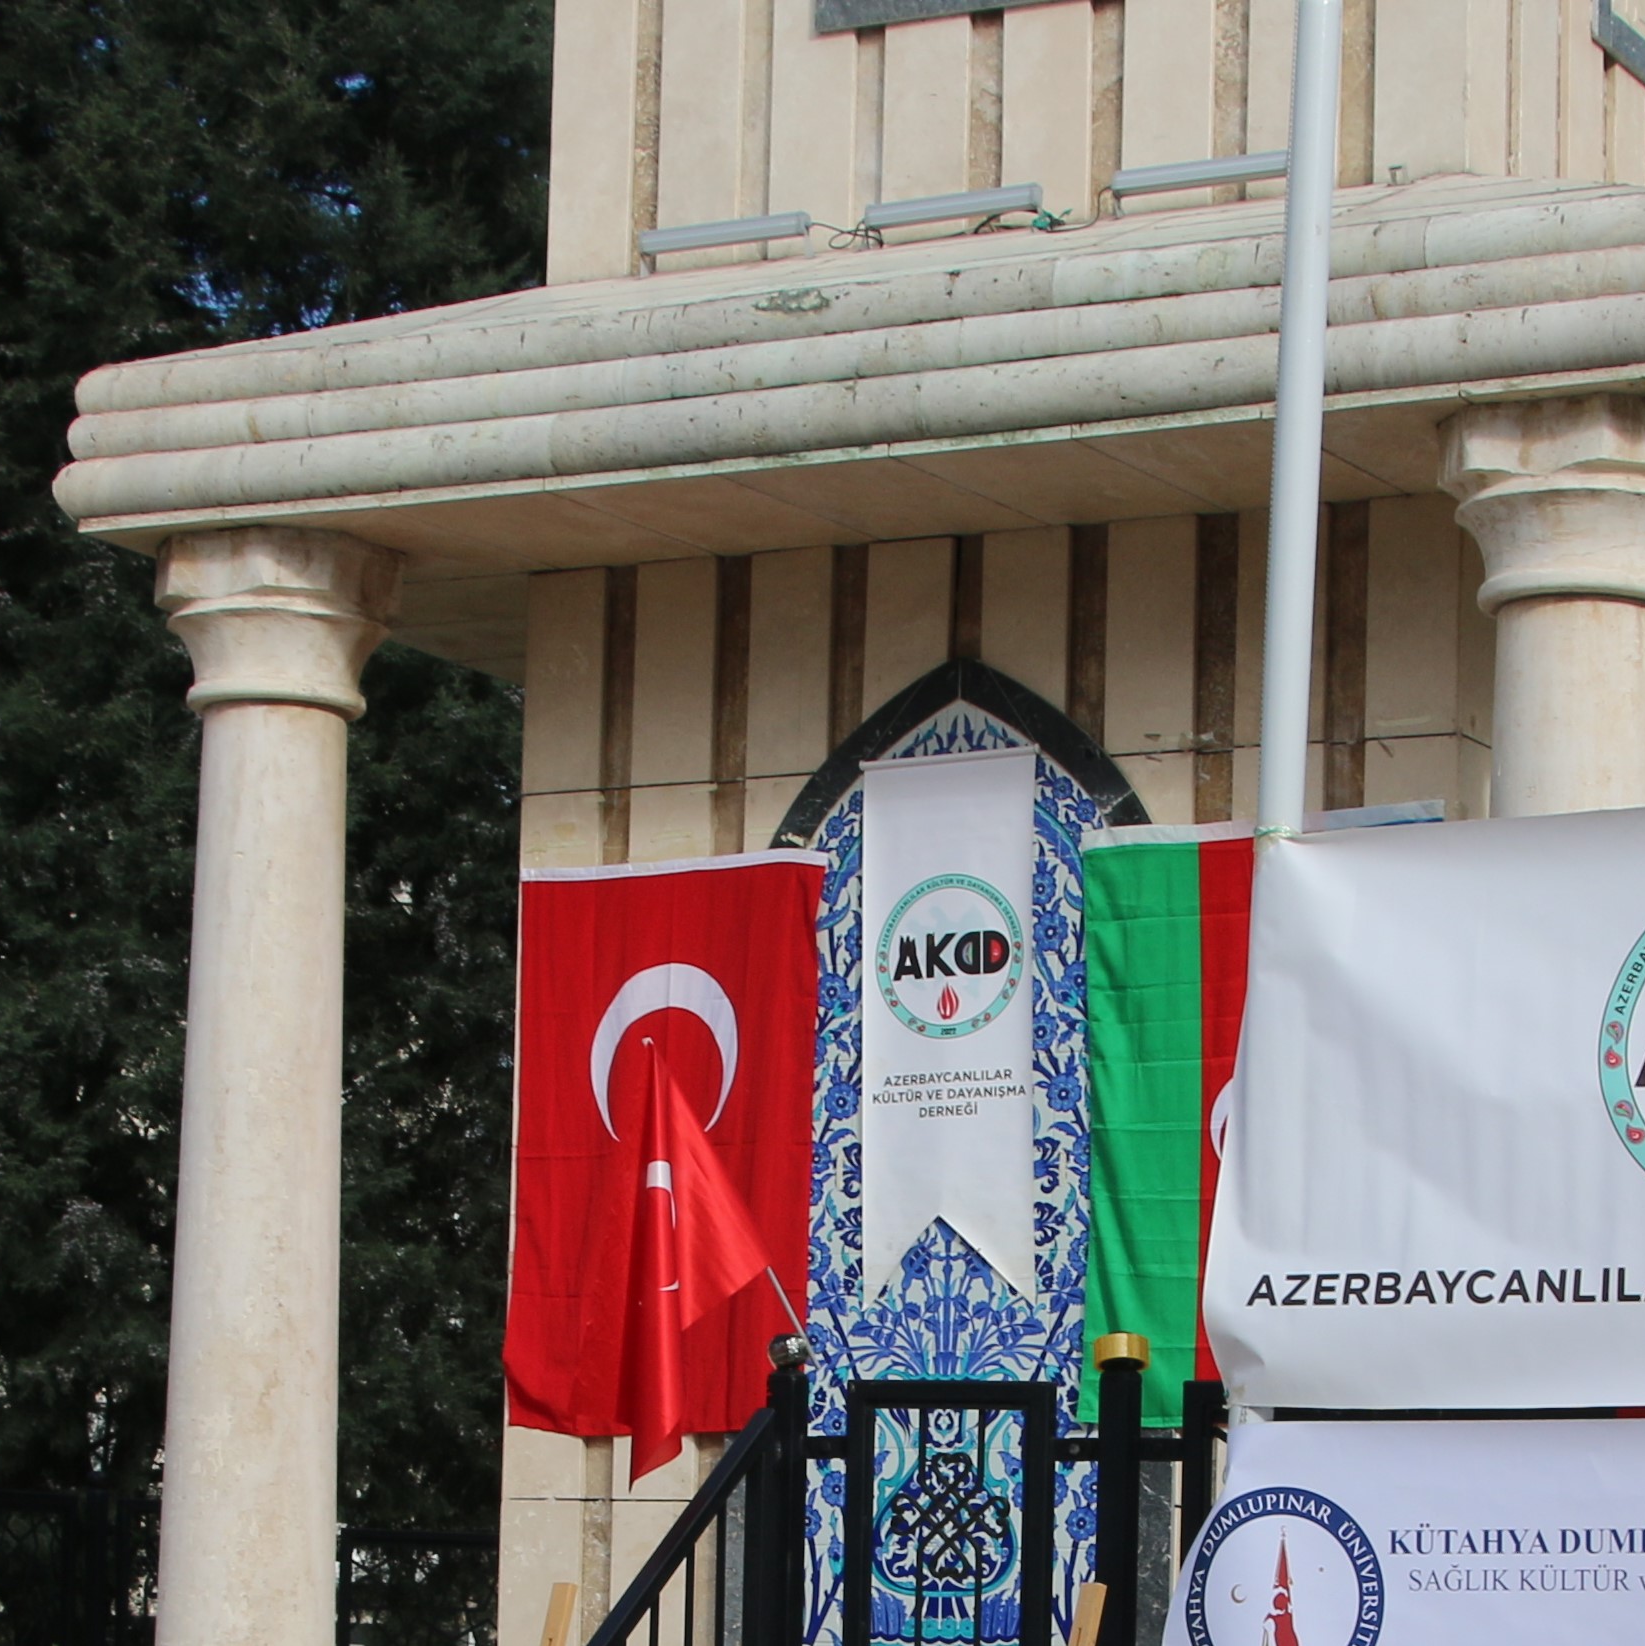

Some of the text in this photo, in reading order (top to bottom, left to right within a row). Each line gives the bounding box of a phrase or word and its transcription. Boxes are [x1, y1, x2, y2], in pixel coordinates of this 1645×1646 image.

[883, 1068, 1013, 1088] AZERBAYCANLILAR
[872, 1085, 1027, 1105] KÜLTÜR VE DAYANIŞMA
[919, 1102, 979, 1119] DERNEĞİ
[1201, 1493, 1332, 1558] DUMLUPINAR
[1389, 1522, 1551, 1555] KÜTAHYA
[1408, 1564, 1510, 1593] SAĞLIK
[1519, 1564, 1632, 1592] KÜLTÜR
